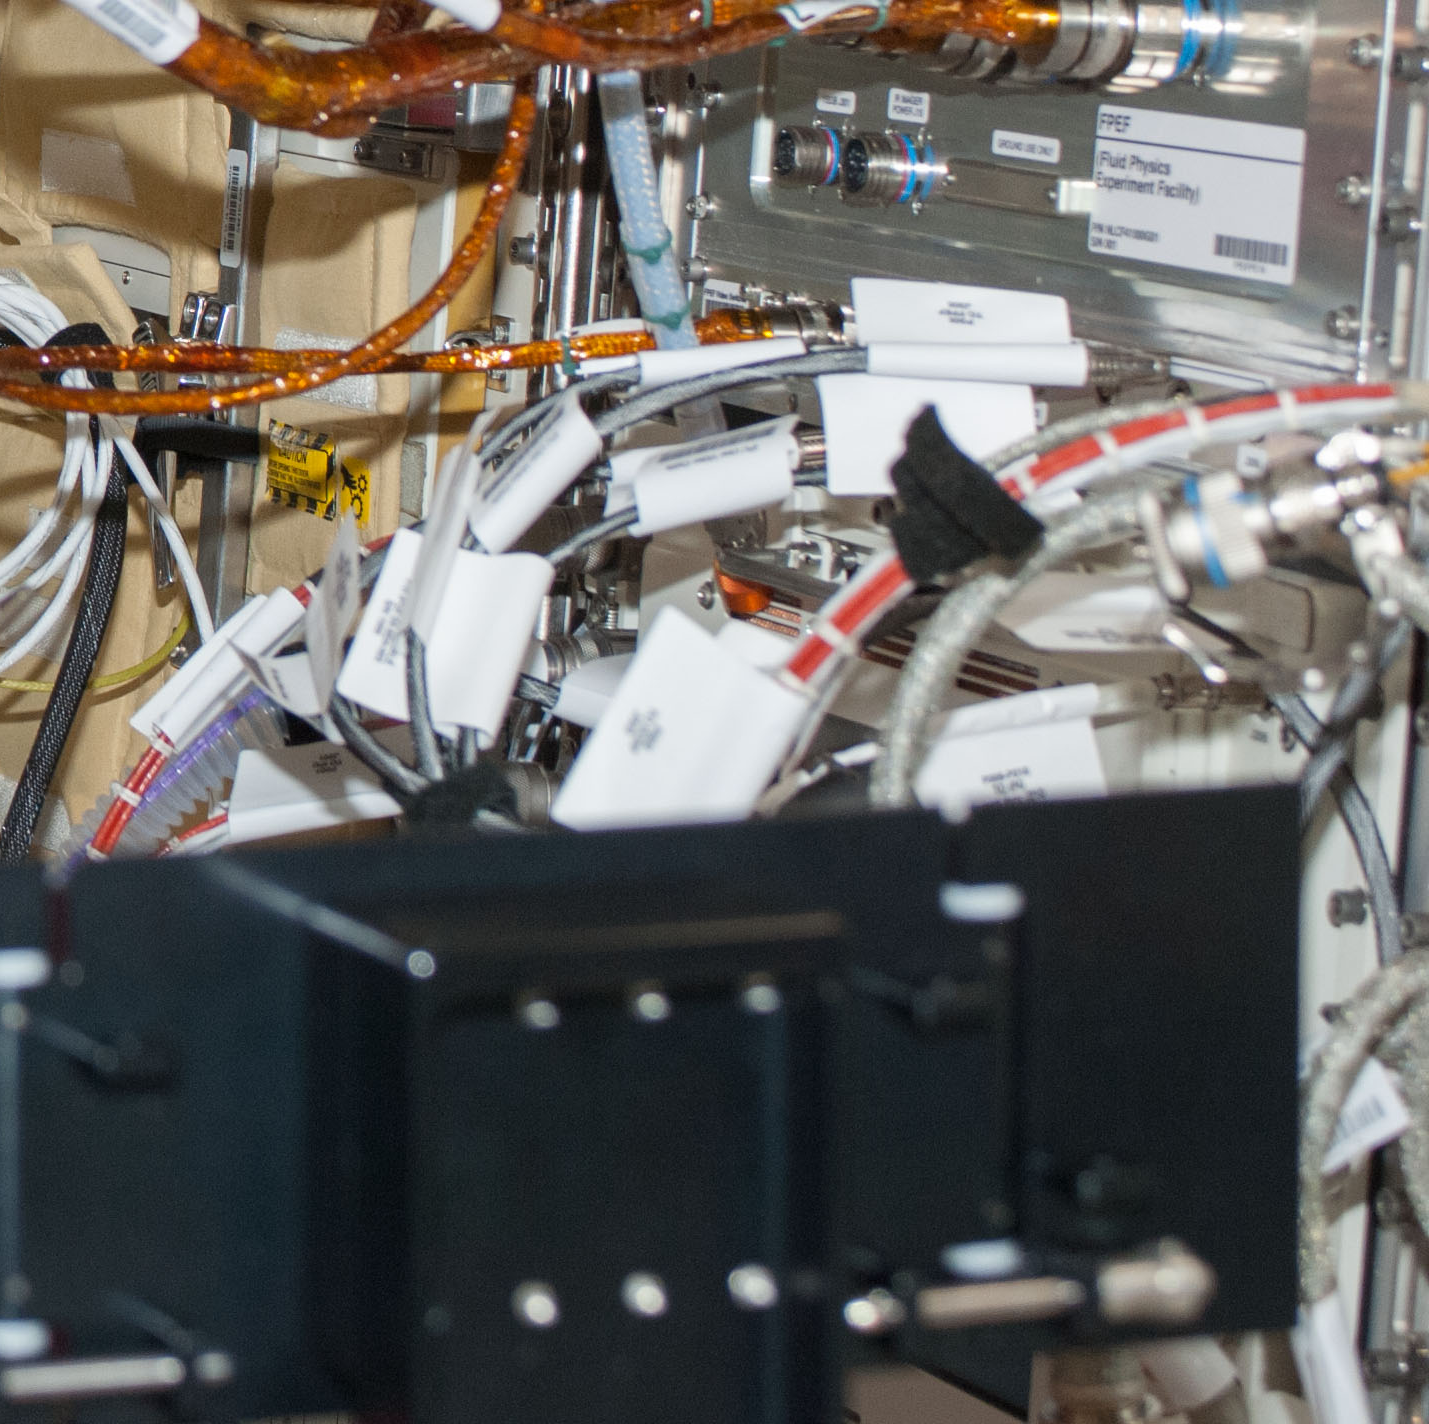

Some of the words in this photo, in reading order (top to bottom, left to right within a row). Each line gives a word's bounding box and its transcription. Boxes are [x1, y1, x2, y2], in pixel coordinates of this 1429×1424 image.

[1098, 112, 1131, 133] FPEF
[997, 138, 1023, 153] GROUND
[1096, 150, 1126, 170] (Fluid
[1128, 153, 1172, 177] Physics
[1095, 171, 1155, 196] Experiment
[1156, 179, 1202, 206] Facility)
[277, 447, 309, 465] CAUTION
